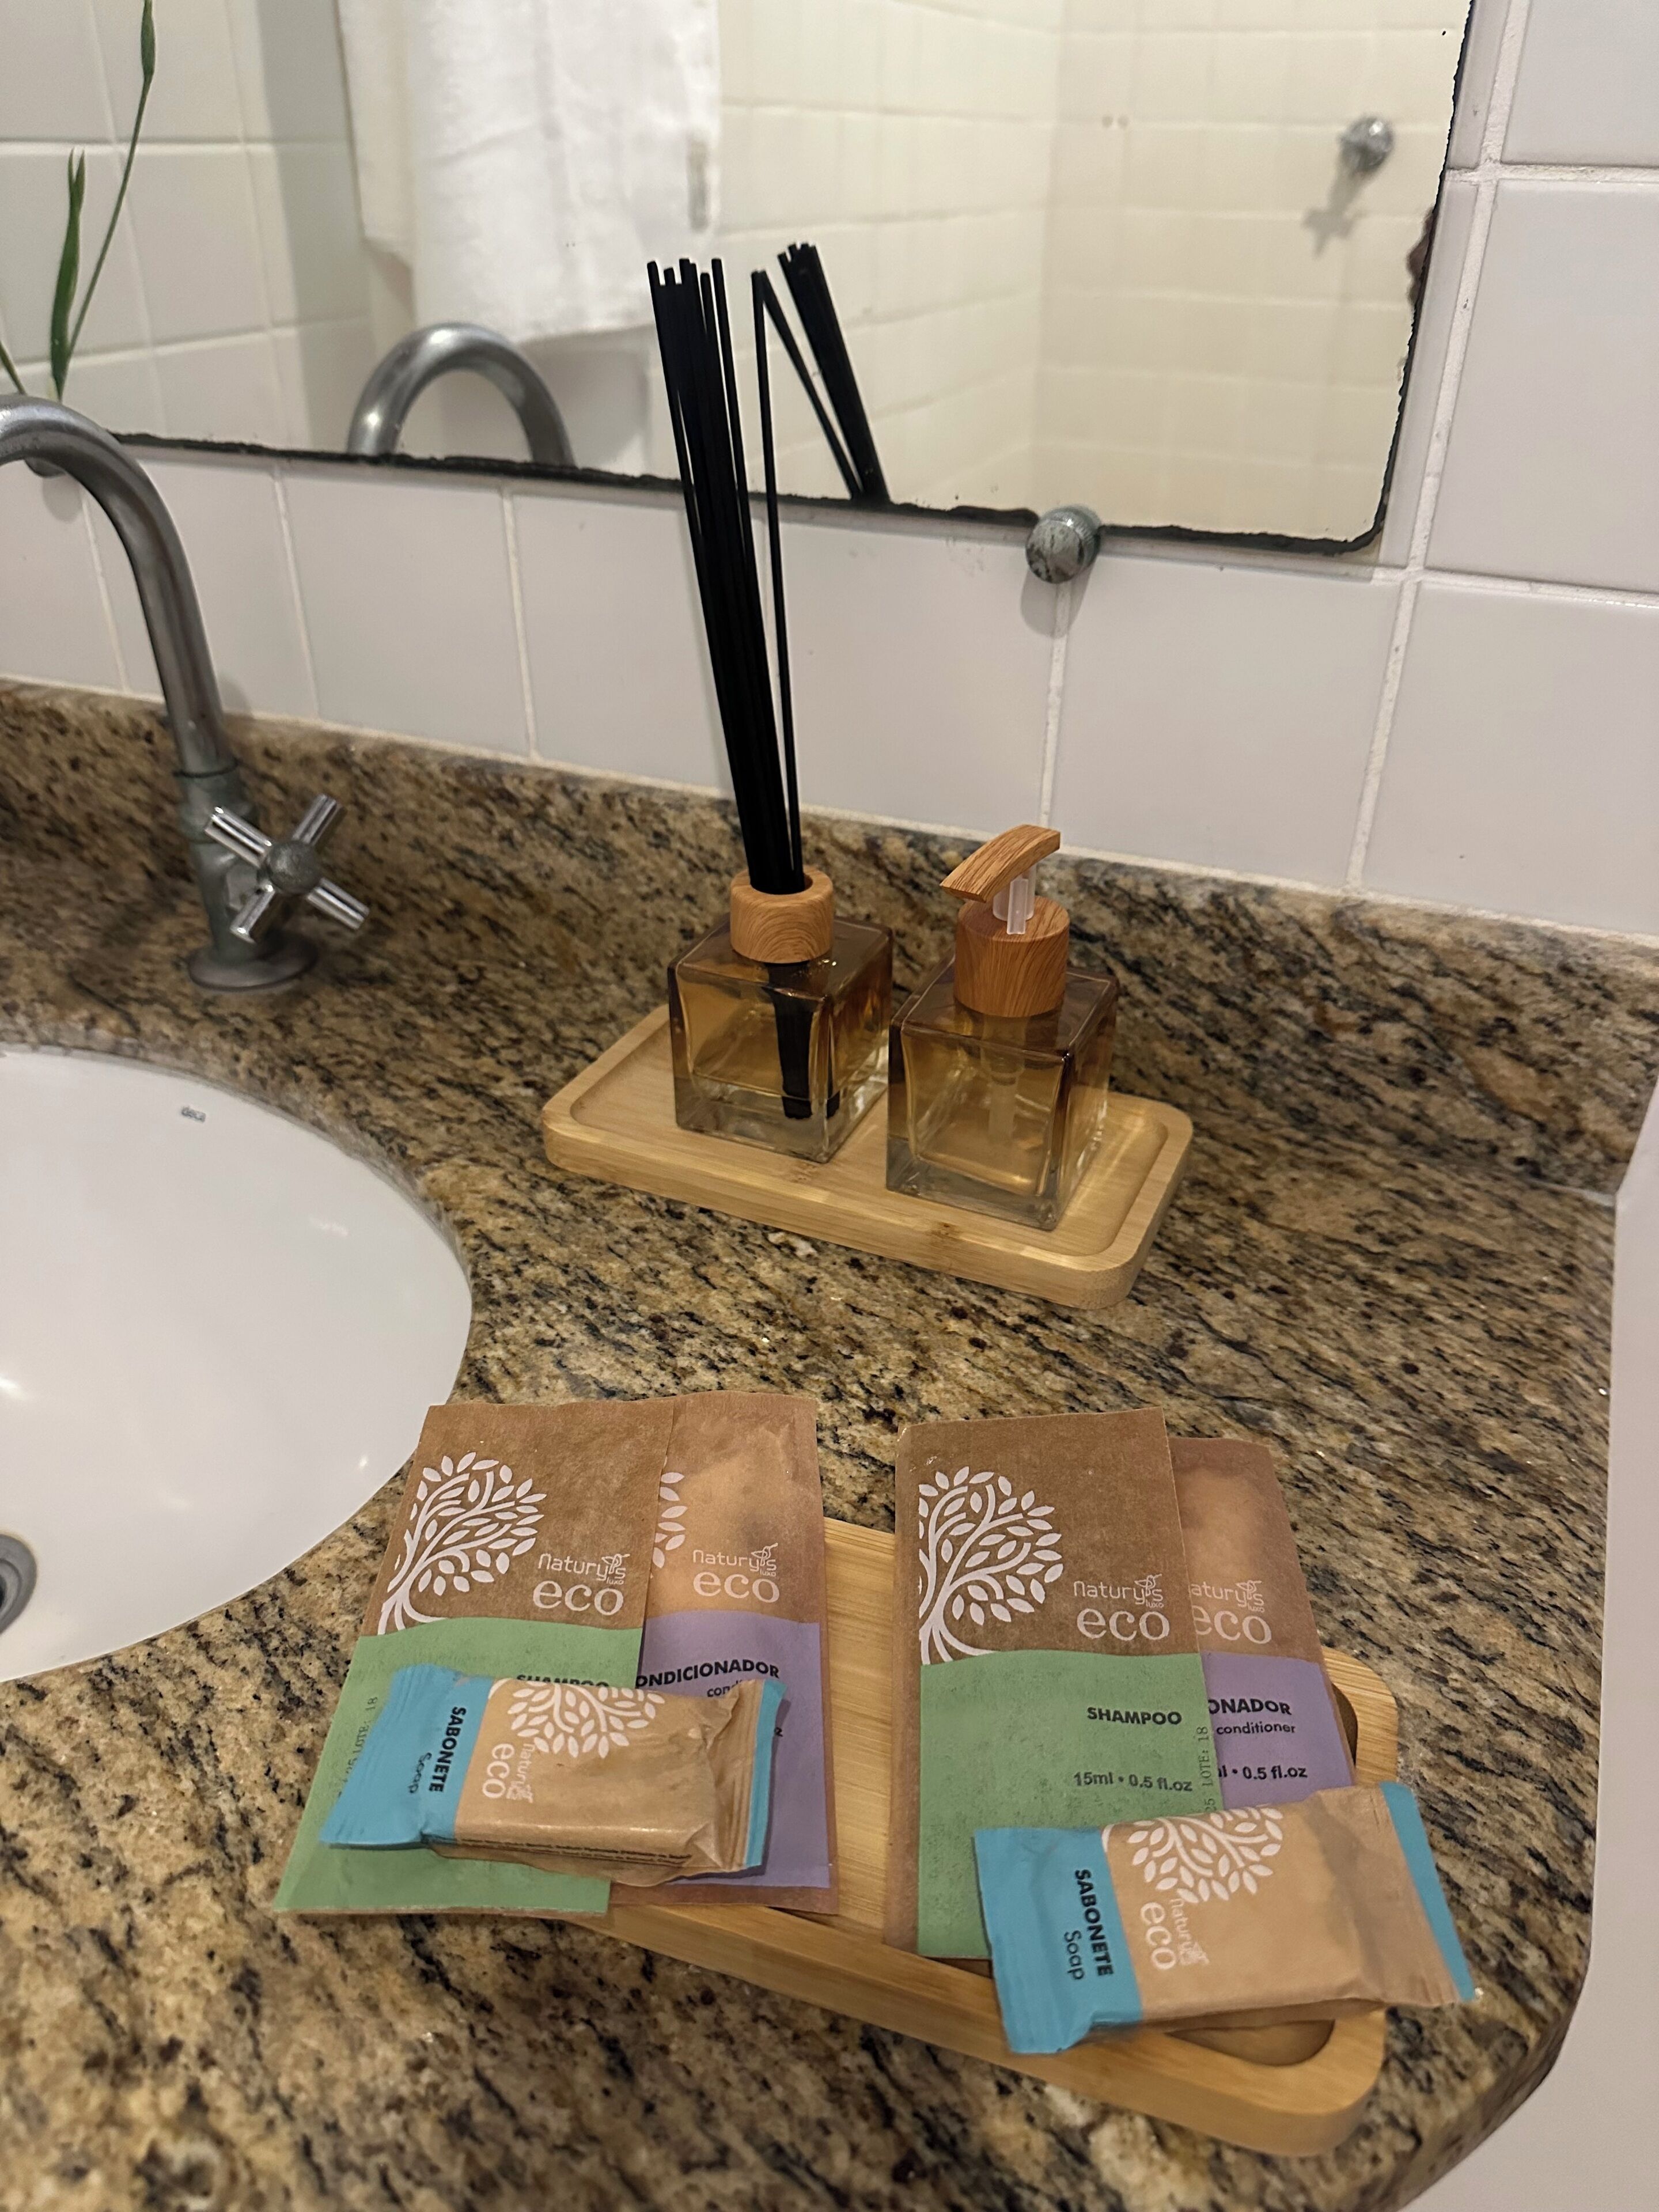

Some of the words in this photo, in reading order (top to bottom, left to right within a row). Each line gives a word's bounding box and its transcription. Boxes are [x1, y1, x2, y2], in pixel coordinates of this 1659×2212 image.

[533, 1580, 624, 1615] eco
[694, 1571, 780, 1603] eco
[1077, 1608, 1170, 1641] eco
[1192, 1605, 1272, 1644] eco
[635, 1659, 779, 1688] ONDICIONADOR
[1087, 1707, 1182, 1725] SHAMPOO
[1217, 1721, 1296, 1734] conditioner
[429, 1706, 467, 1793] SABONETE
[1196, 1726, 1209, 1741] 18
[482, 1743, 515, 1798] eco
[1074, 1771, 1113, 1786] 15ml
[1129, 1774, 1153, 1788] 0.5
[1157, 1777, 1193, 1791] fl.oz
[1242, 1766, 1267, 1780] 0.5
[1271, 1764, 1308, 1779] fl.oz
[1075, 1869, 1114, 1976] SABONETE
[1141, 1902, 1177, 1970] eco
[1065, 1930, 1085, 1980] Soap
